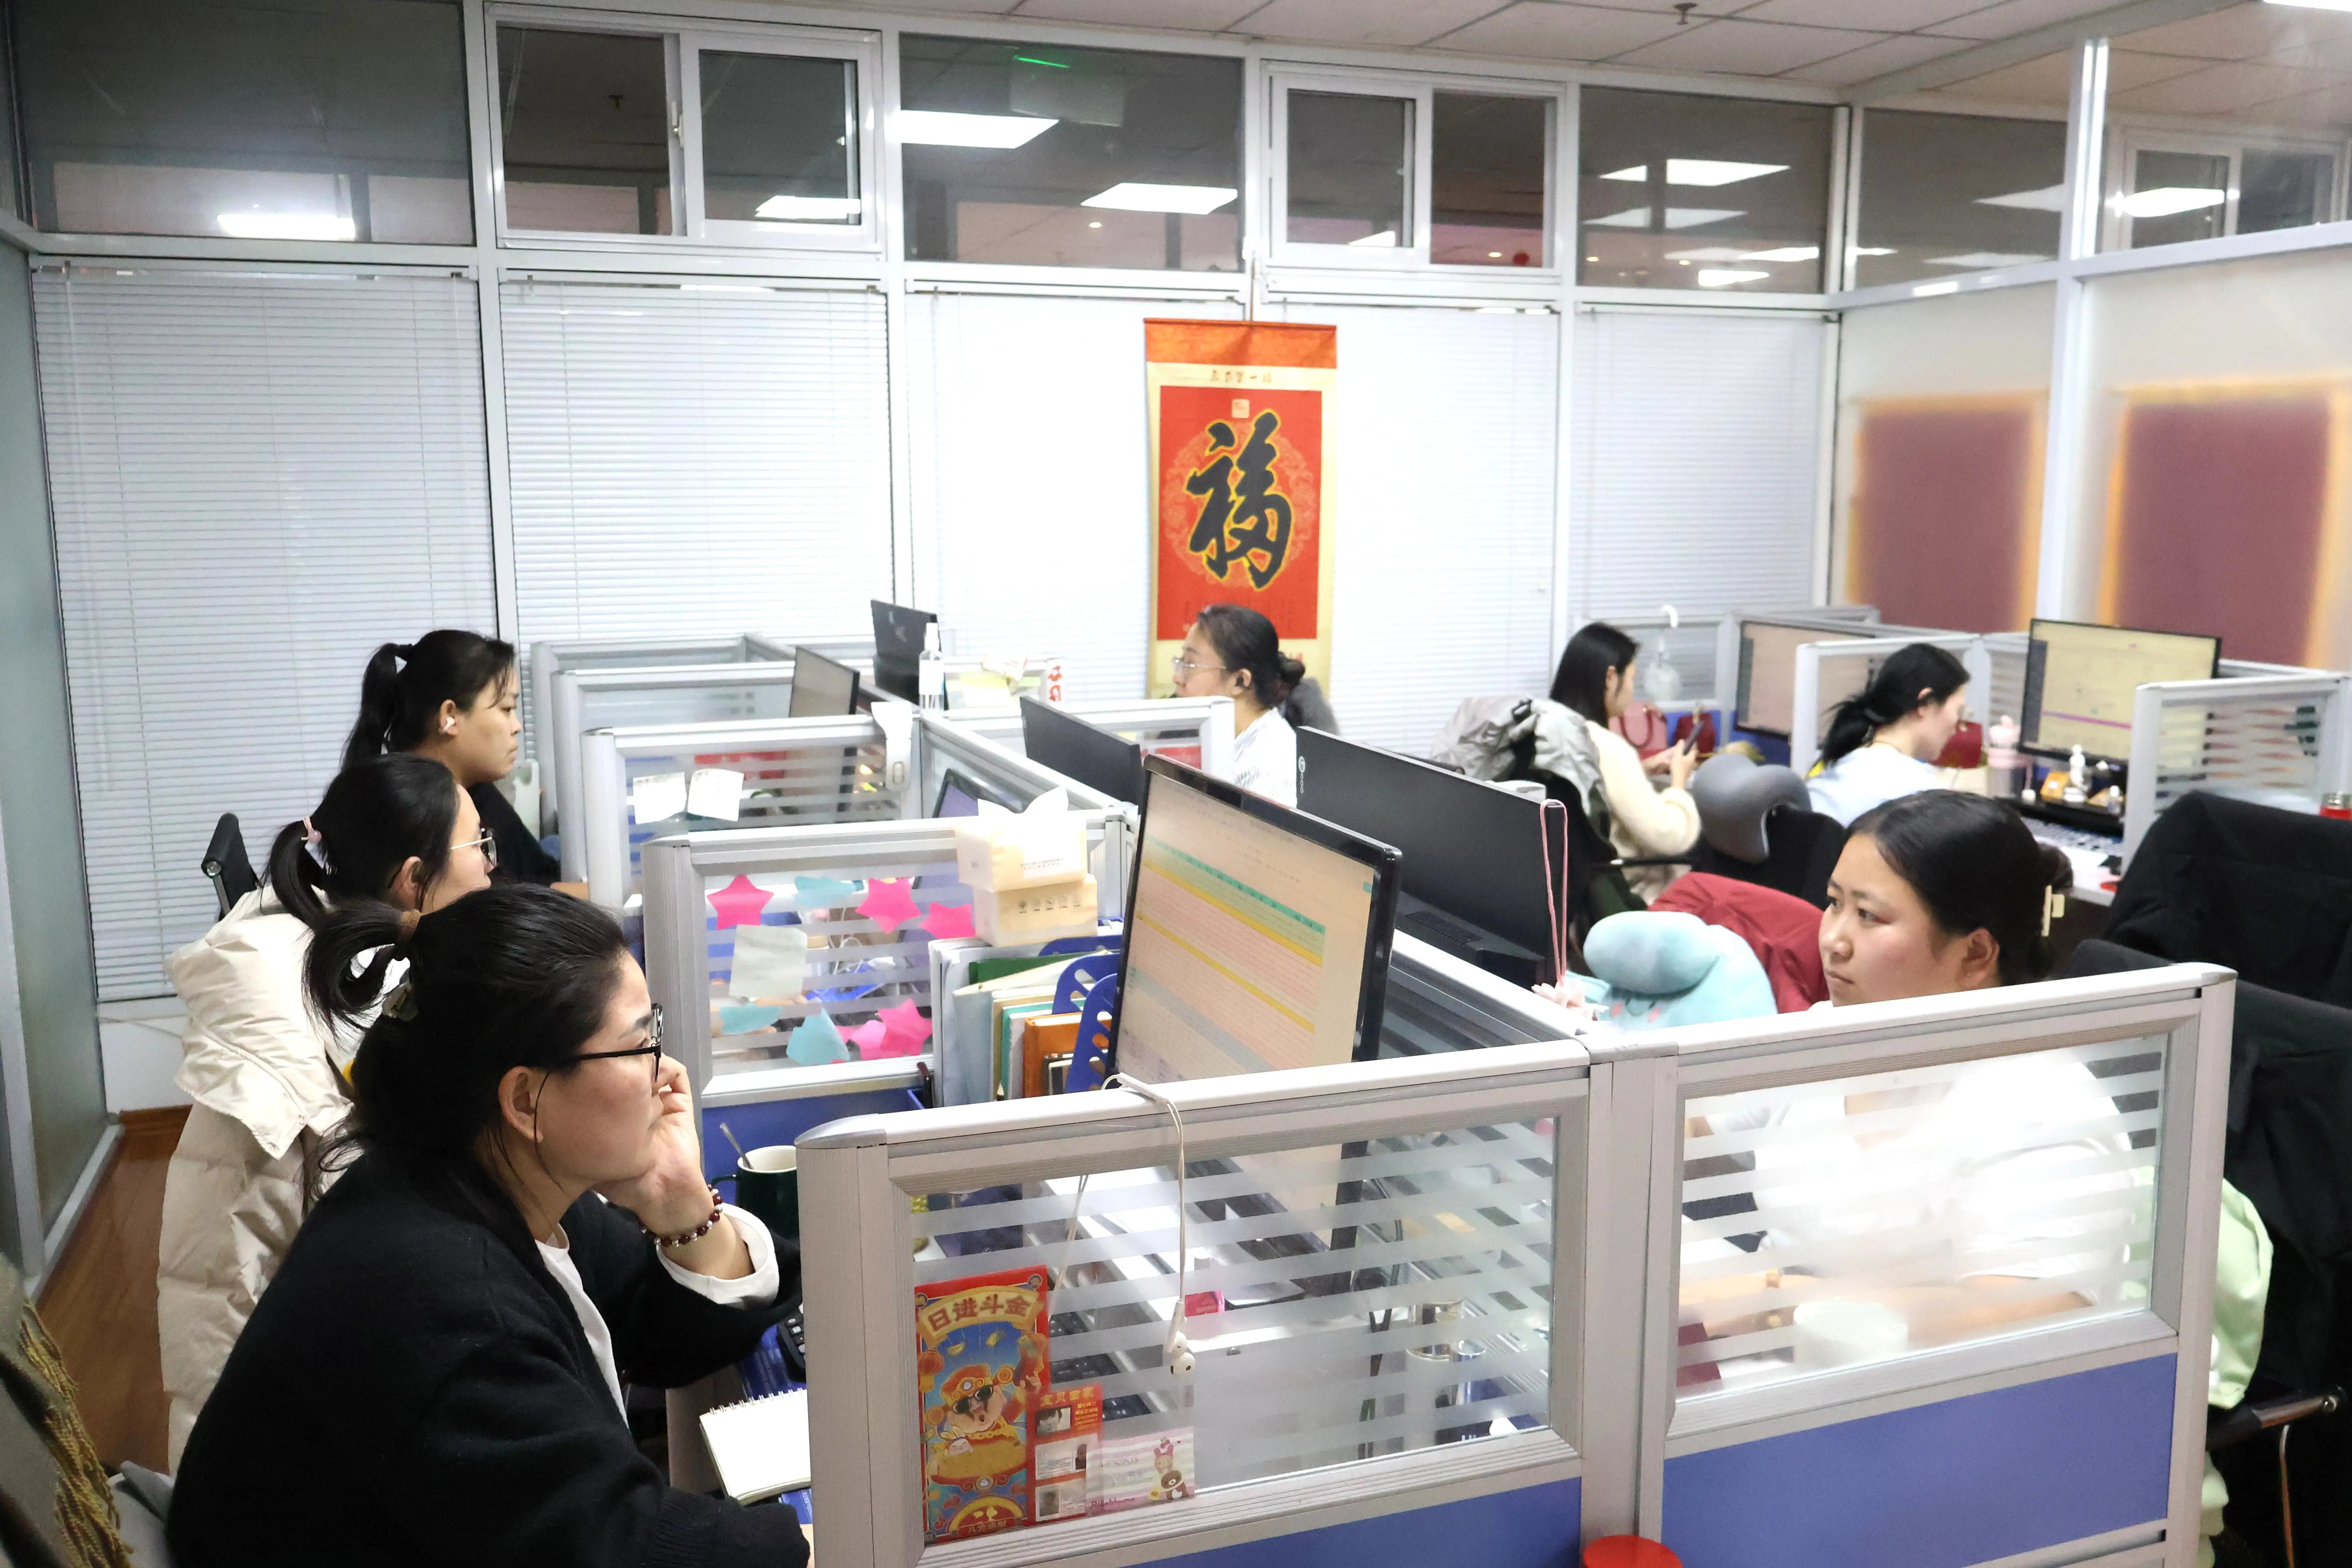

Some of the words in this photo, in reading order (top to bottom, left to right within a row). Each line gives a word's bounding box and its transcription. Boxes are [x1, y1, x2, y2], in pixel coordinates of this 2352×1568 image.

[1186, 410, 1294, 590] 福
[927, 1293, 1030, 1332] 日进斗金
